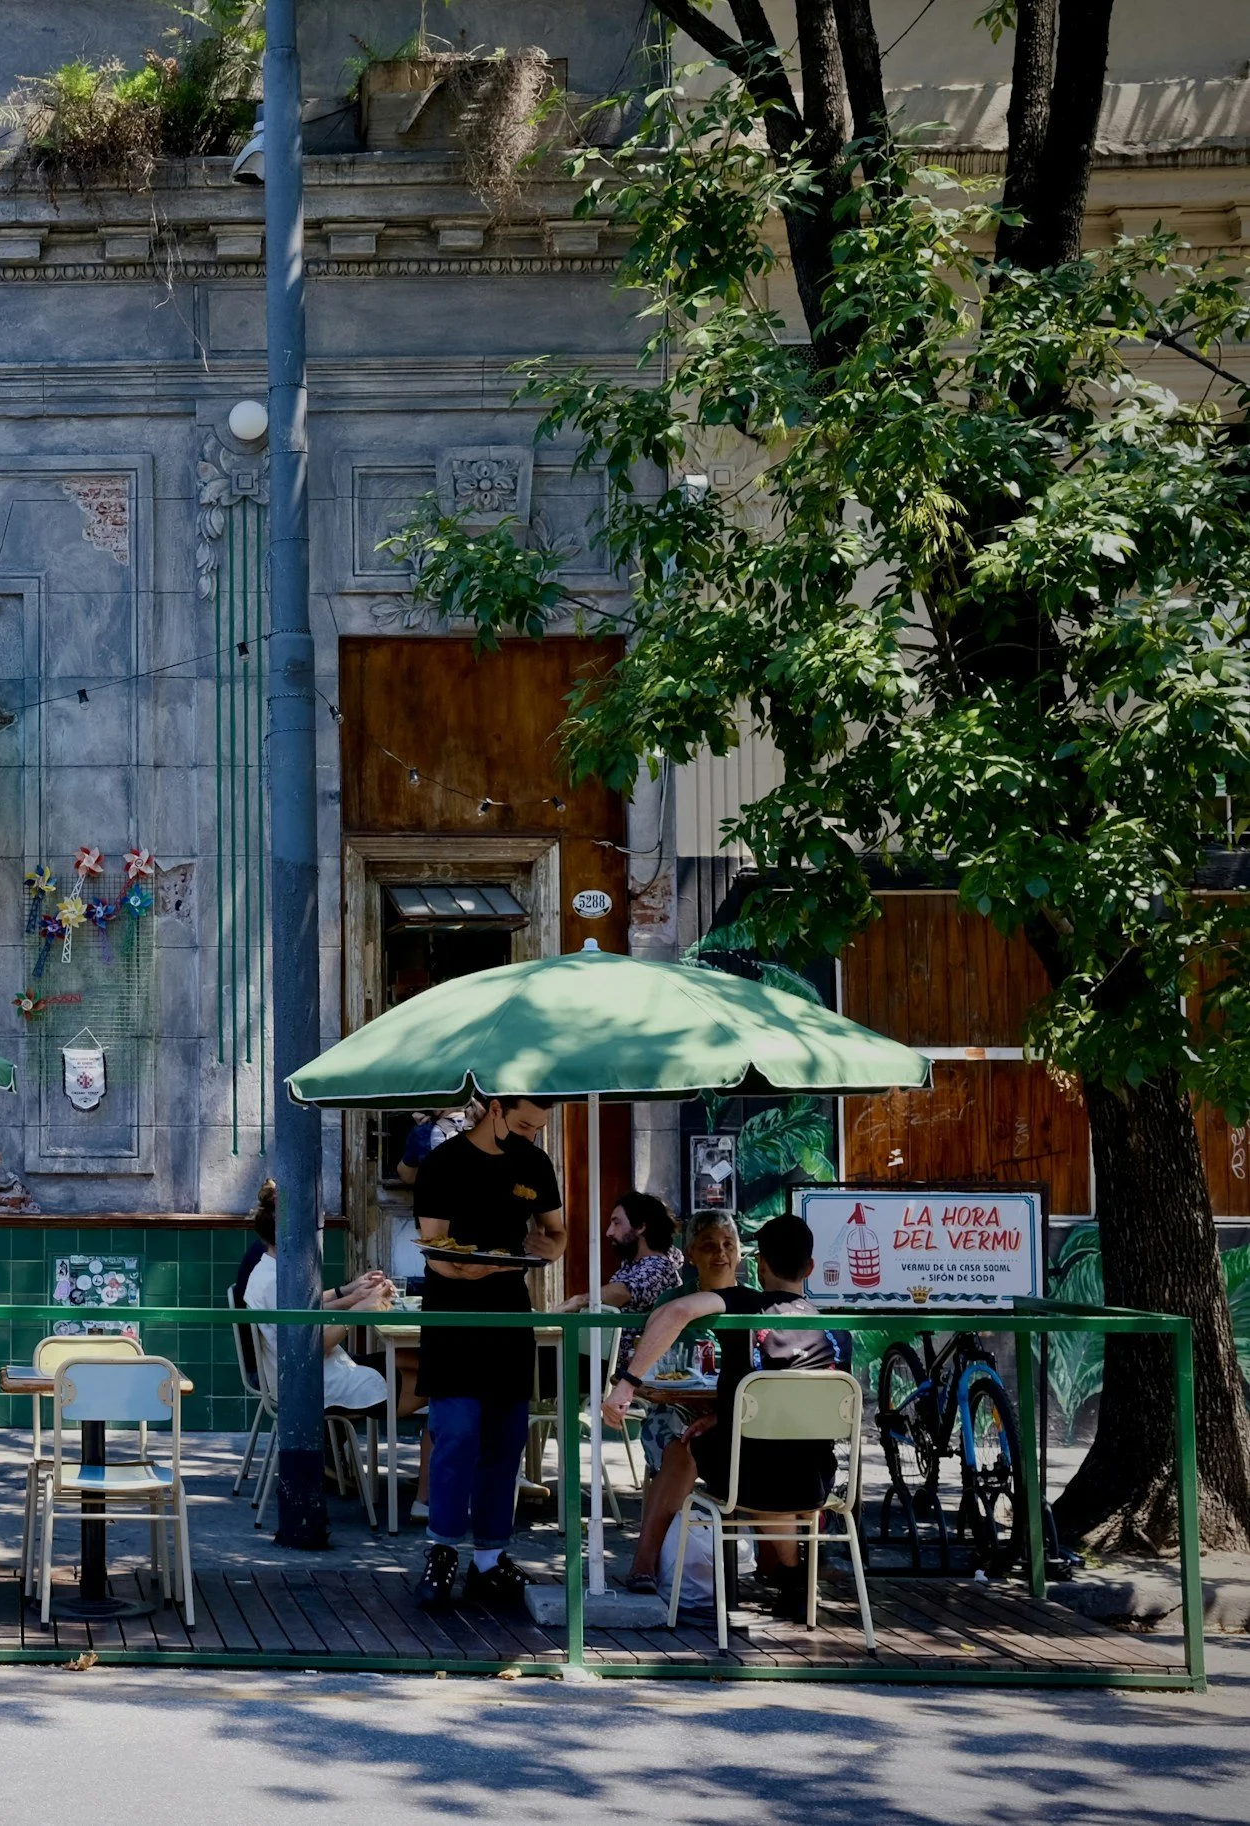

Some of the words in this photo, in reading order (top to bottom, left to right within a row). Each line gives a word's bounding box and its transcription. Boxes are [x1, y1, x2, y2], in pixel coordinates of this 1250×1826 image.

[578, 894, 606, 909] 5288
[903, 1205, 932, 1228] LA
[941, 1206, 1002, 1228] HORA
[893, 1229, 938, 1251] DEL
[947, 1227, 1022, 1251] VERMÚ
[901, 1263, 930, 1272] VERMU
[933, 1263, 944, 1272] DE
[946, 1264, 957, 1272] LA
[959, 1264, 981, 1272] CASA
[983, 1264, 1011, 1272] 500ML
[929, 1272, 954, 1282] SIFÓN
[957, 1274, 969, 1282] DE
[970, 1274, 995, 1282] SODA
